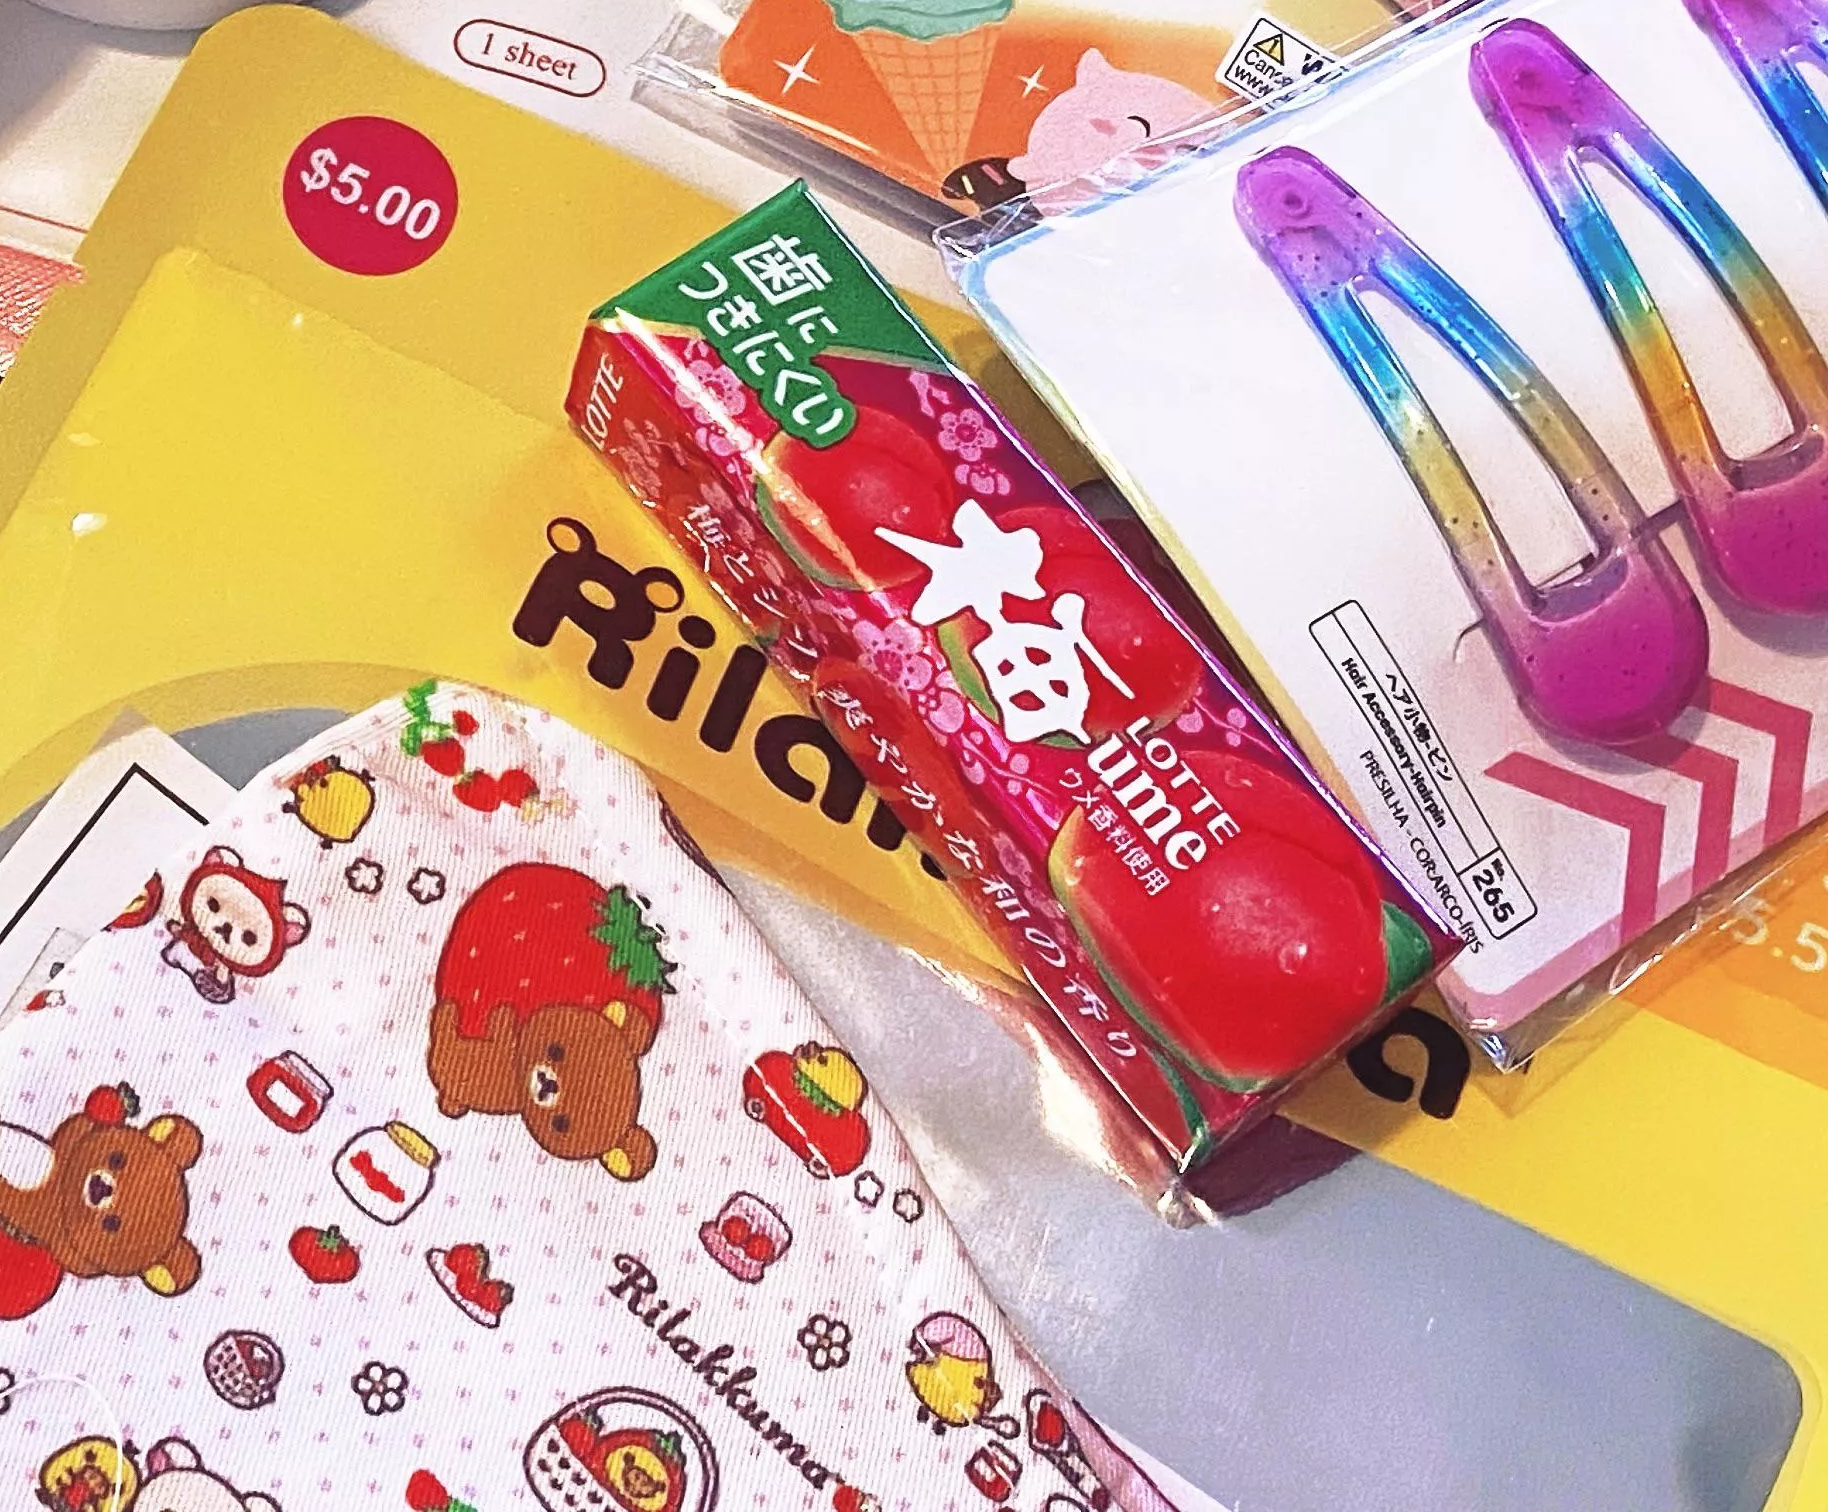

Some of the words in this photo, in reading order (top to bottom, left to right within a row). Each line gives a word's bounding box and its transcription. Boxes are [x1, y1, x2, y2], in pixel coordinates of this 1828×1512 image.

[504, 39, 579, 82] sheet
[300, 147, 442, 241] $5.00
[731, 233, 842, 346] 歯に
[678, 259, 847, 438] つきにくい
[580, 353, 625, 454] LOTTE
[1340, 656, 1368, 690] Hair
[1059, 765, 1171, 897] ウメ香料使用
[1086, 730, 1208, 873] ume
[1126, 714, 1242, 848] LOTTE
[1359, 748, 1410, 830] PRESILHA
[1471, 868, 1516, 925] 265
[611, 1251, 837, 1492] Rilakkuma
